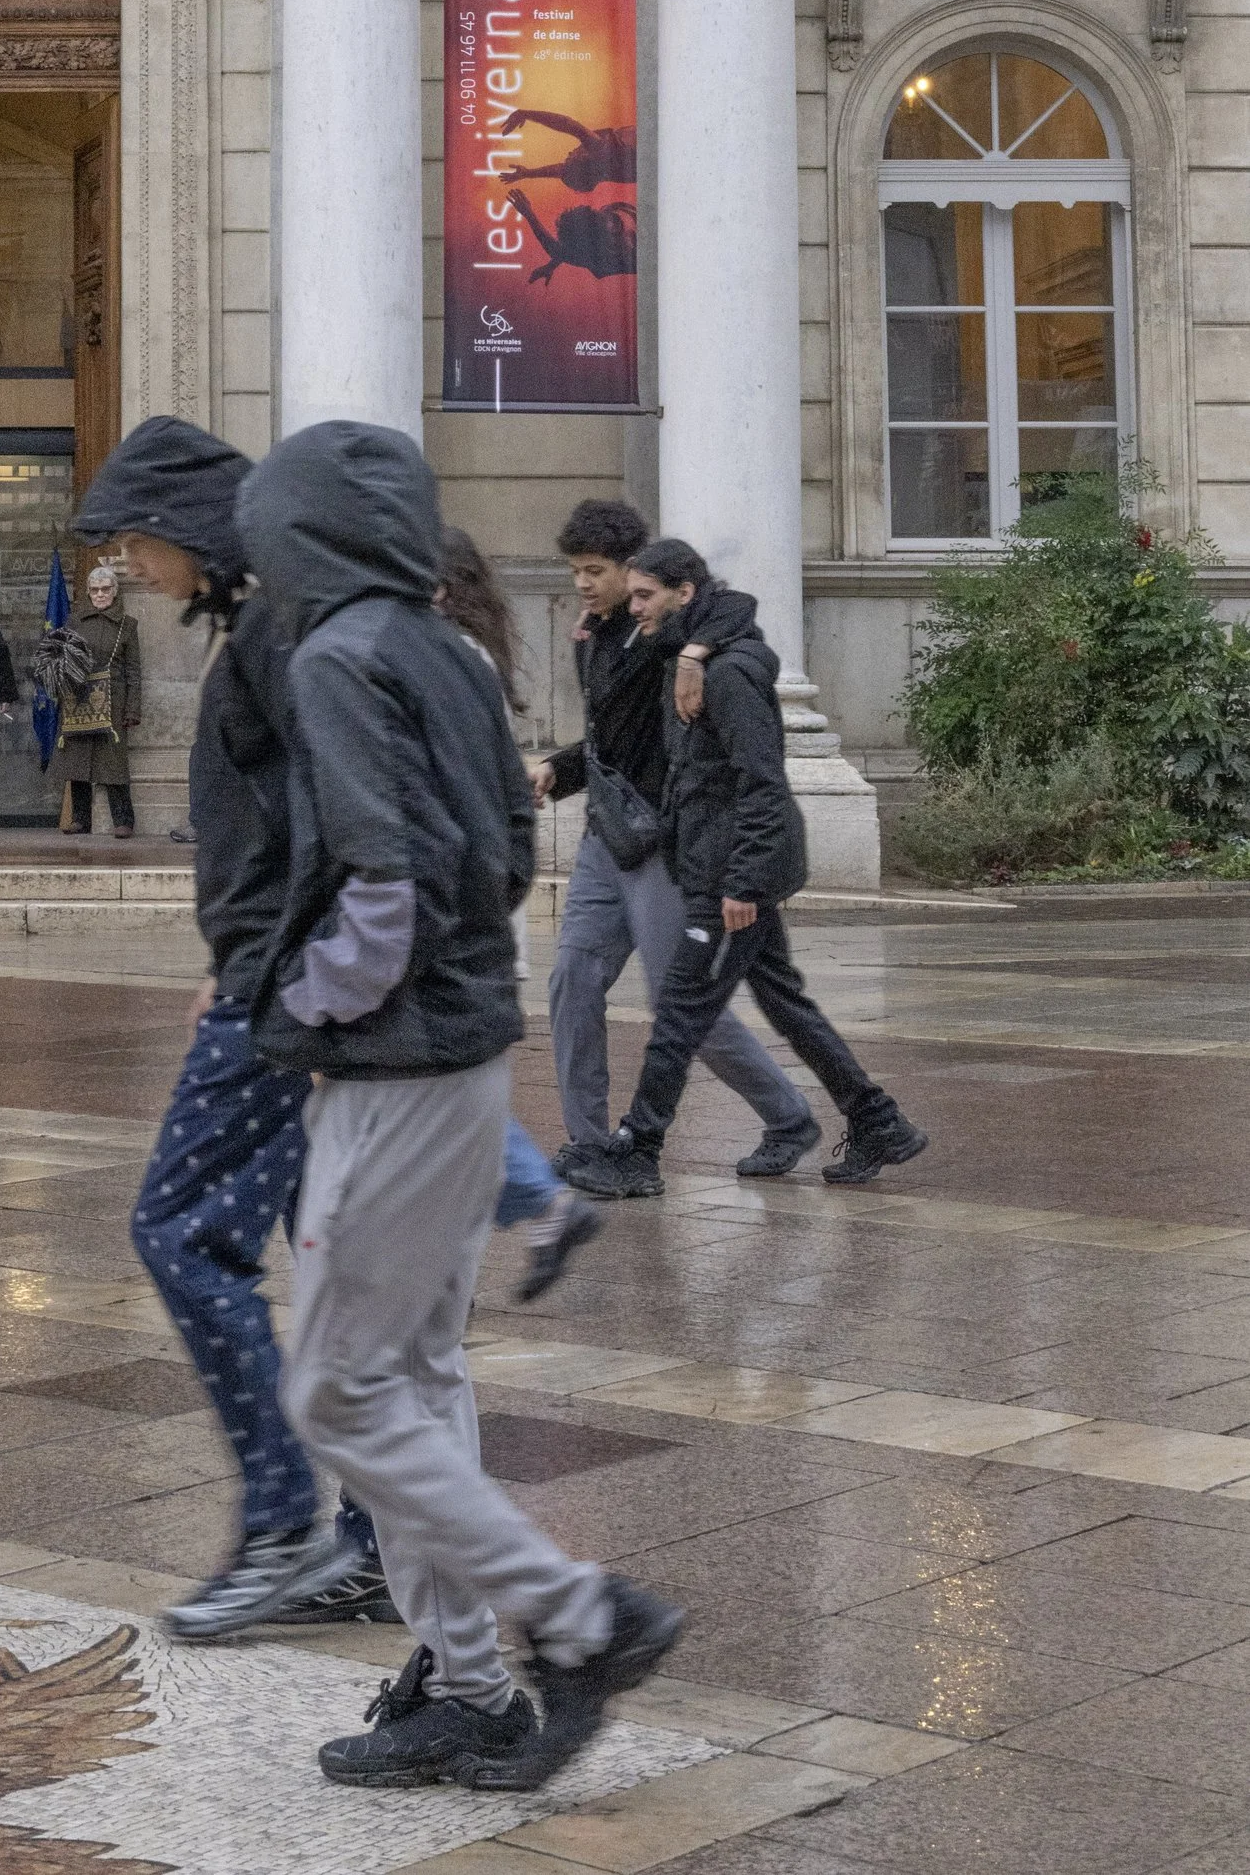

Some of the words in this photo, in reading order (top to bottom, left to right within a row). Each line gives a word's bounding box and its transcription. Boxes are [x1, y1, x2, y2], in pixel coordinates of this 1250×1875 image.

[460, 11, 475, 31] 45
[533, 9, 574, 20] festival
[533, 30, 547, 40] de
[549, 30, 581, 40] danse
[460, 35, 476, 57] 46
[554, 50, 591, 61] édition
[460, 61, 476, 74] 11
[460, 78, 477, 99] 90
[460, 103, 477, 125] 04
[473, 200, 523, 269] les
[491, 345, 522, 353] d'Avignon
[575, 341, 617, 351] AVIGNON
